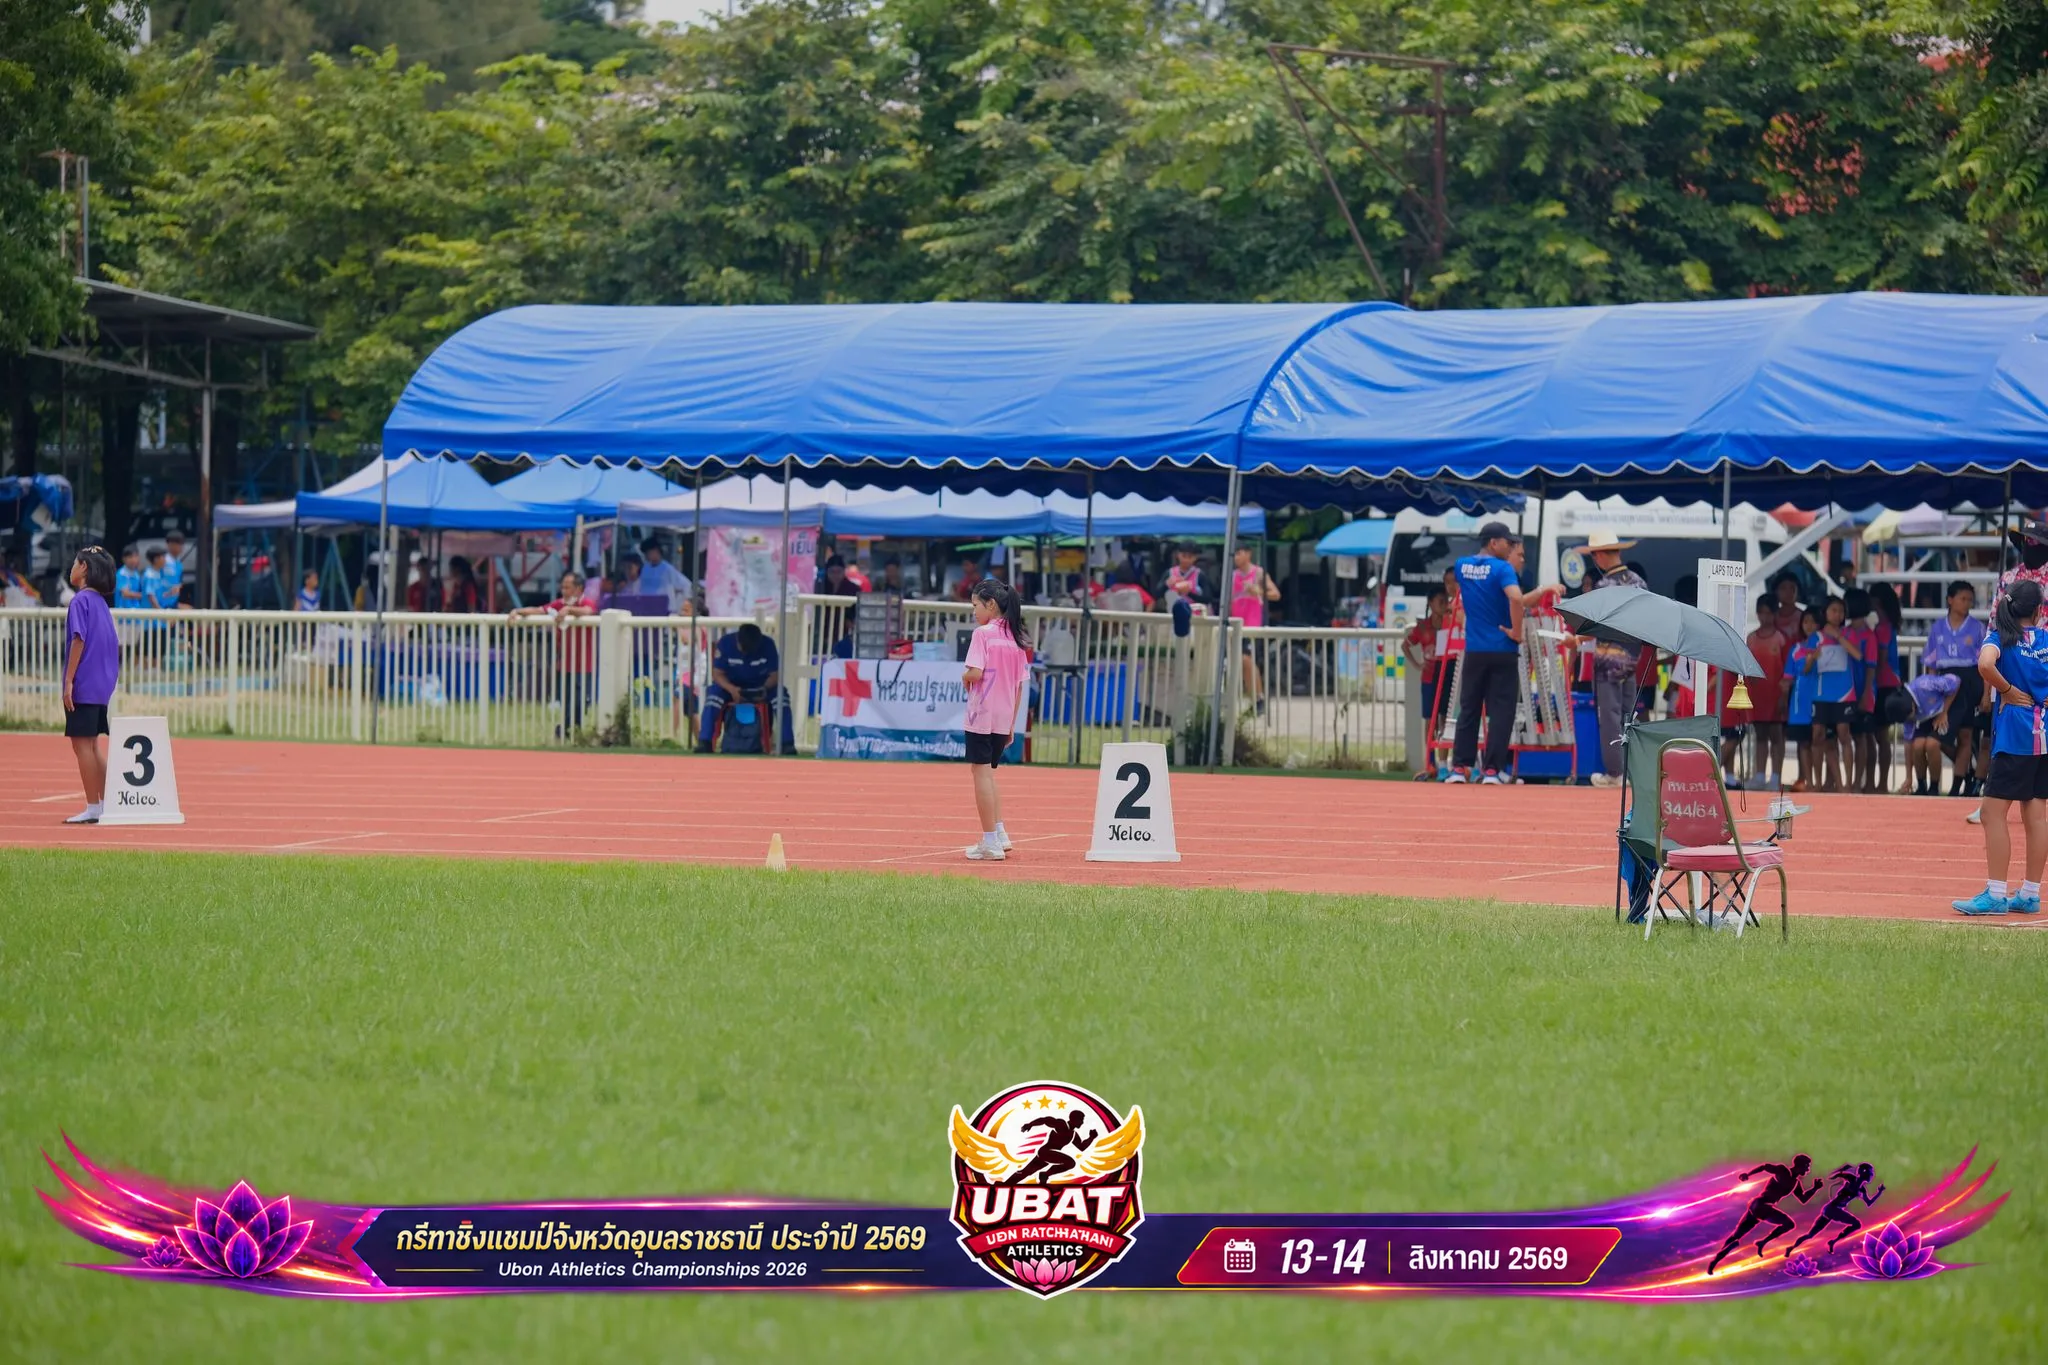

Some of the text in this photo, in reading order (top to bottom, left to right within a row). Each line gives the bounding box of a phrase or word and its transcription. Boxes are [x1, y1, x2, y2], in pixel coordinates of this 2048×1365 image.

[1712, 564, 1743, 578] LAPS TO GO
[123, 735, 155, 787] 3
[118, 791, 157, 806] Nelco
[1114, 762, 1151, 819] 2
[1663, 800, 1718, 819] 344/64
[1108, 824, 1152, 842] Nelco
